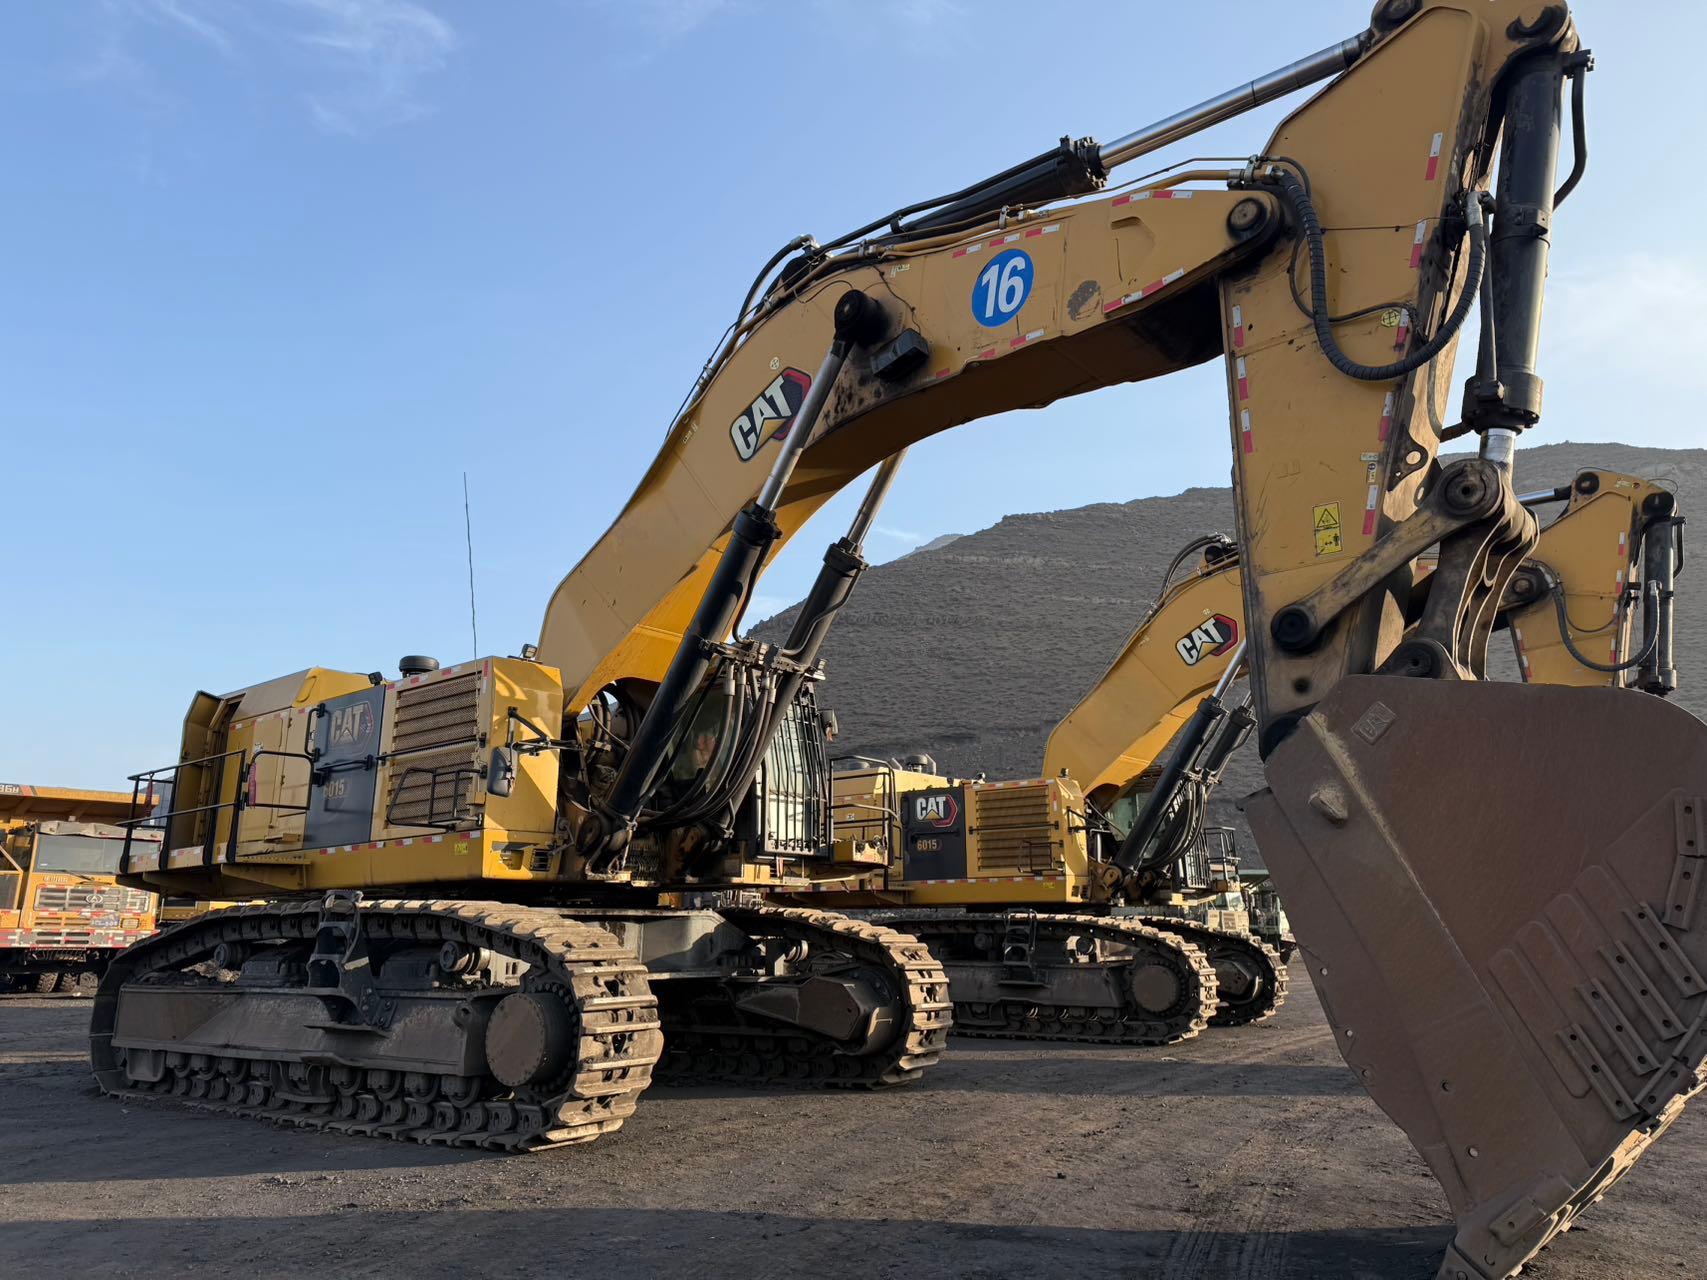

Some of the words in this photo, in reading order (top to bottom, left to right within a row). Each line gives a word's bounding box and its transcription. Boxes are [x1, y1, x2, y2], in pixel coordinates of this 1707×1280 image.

[982, 256, 1026, 318] 16
[731, 374, 793, 459] CAT
[1176, 617, 1225, 665] CAT
[330, 703, 364, 744] CAT
[916, 796, 946, 820] CAT
[916, 840, 938, 850] 6015
